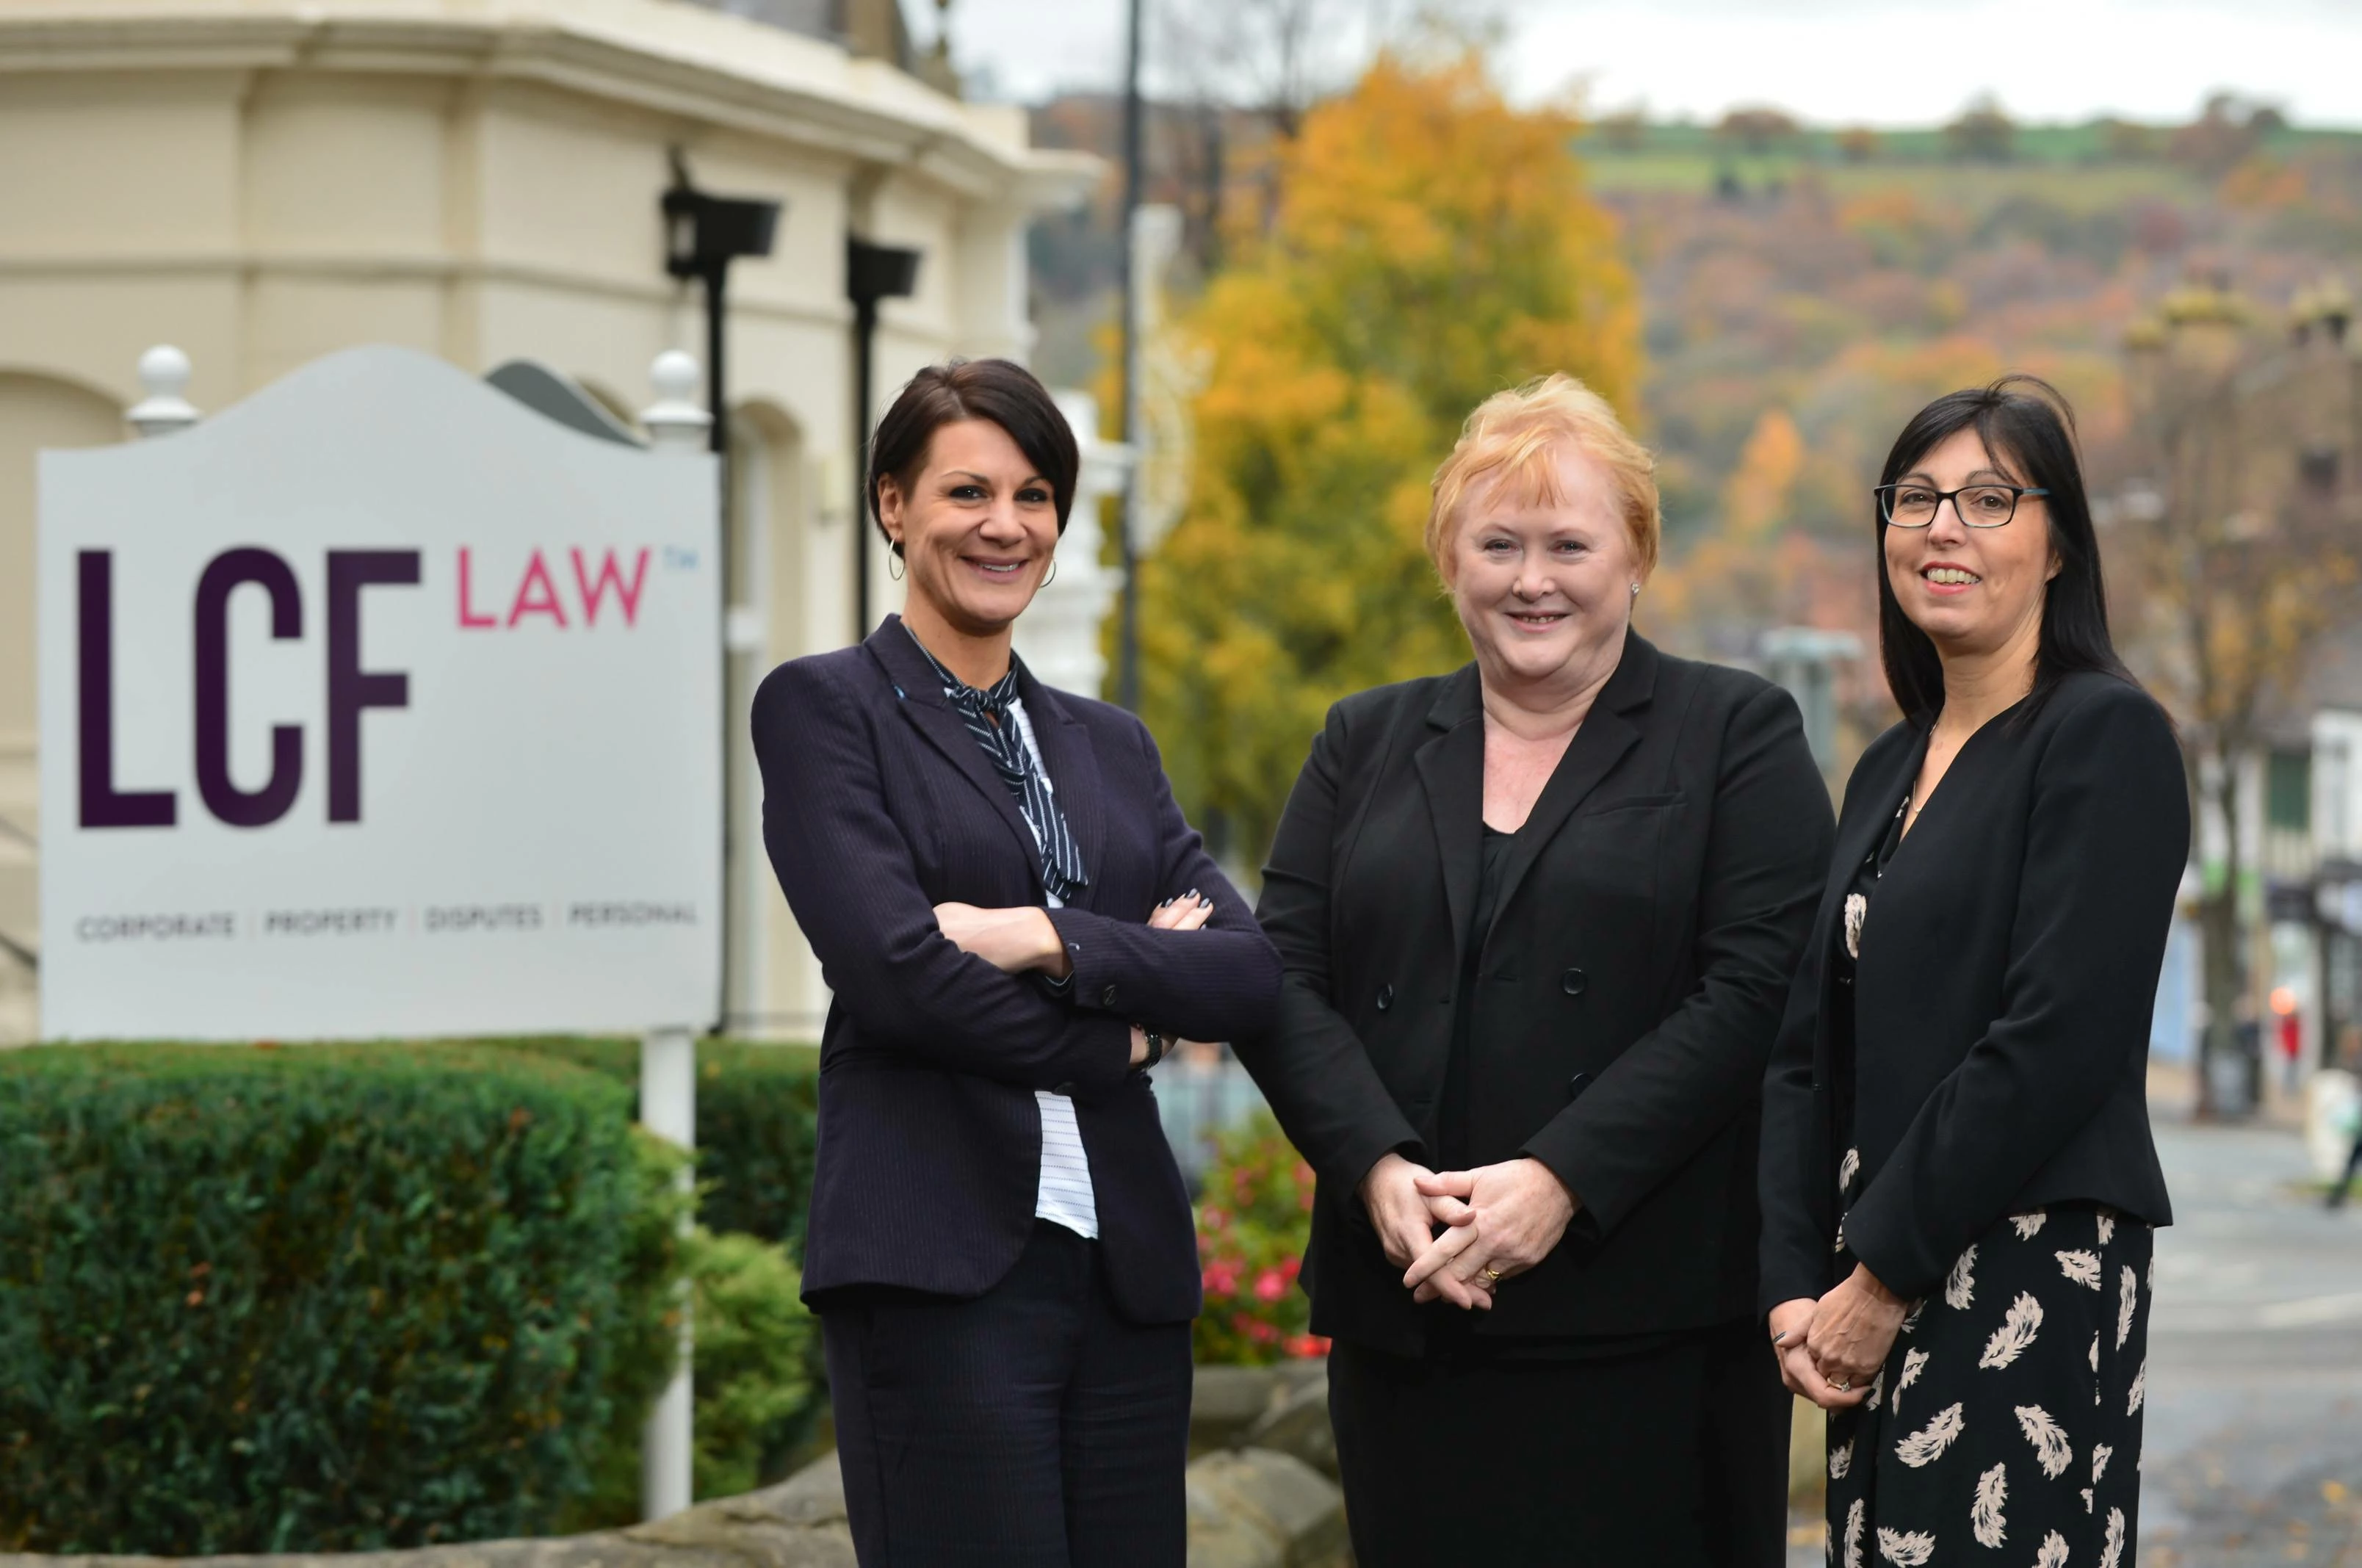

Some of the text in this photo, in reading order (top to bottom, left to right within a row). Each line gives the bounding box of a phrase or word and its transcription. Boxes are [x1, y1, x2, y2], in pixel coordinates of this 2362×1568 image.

[77, 546, 421, 829] LCF
[457, 545, 651, 629] LAW
[76, 900, 699, 942] CORPORATE PROPERTY DISPUTES PERSONAL
